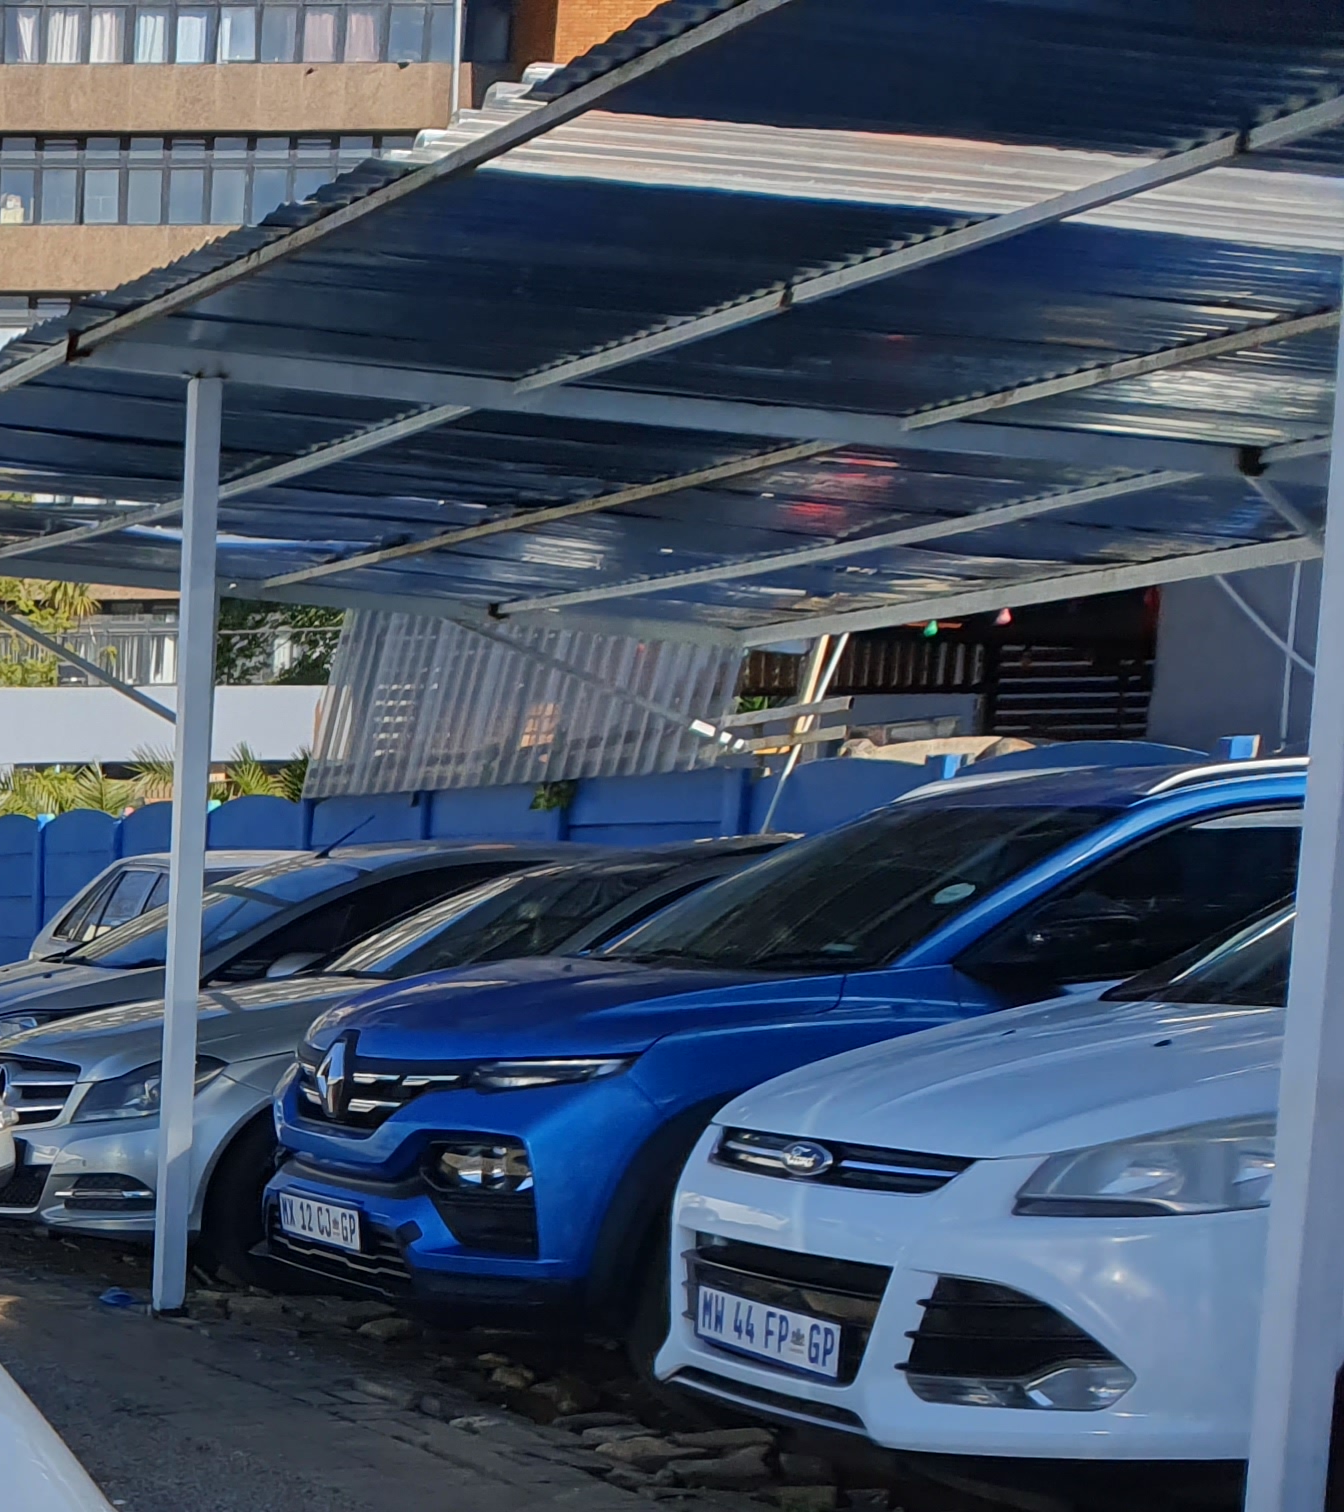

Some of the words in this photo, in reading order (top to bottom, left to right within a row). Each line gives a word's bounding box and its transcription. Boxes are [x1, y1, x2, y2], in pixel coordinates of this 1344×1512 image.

[300, 1201, 313, 1232] 12
[317, 1206, 331, 1237] CJ
[341, 1212, 356, 1243] GP
[733, 1301, 755, 1344] 44
[764, 1311, 789, 1353] FP
[808, 1323, 835, 1367] GP
